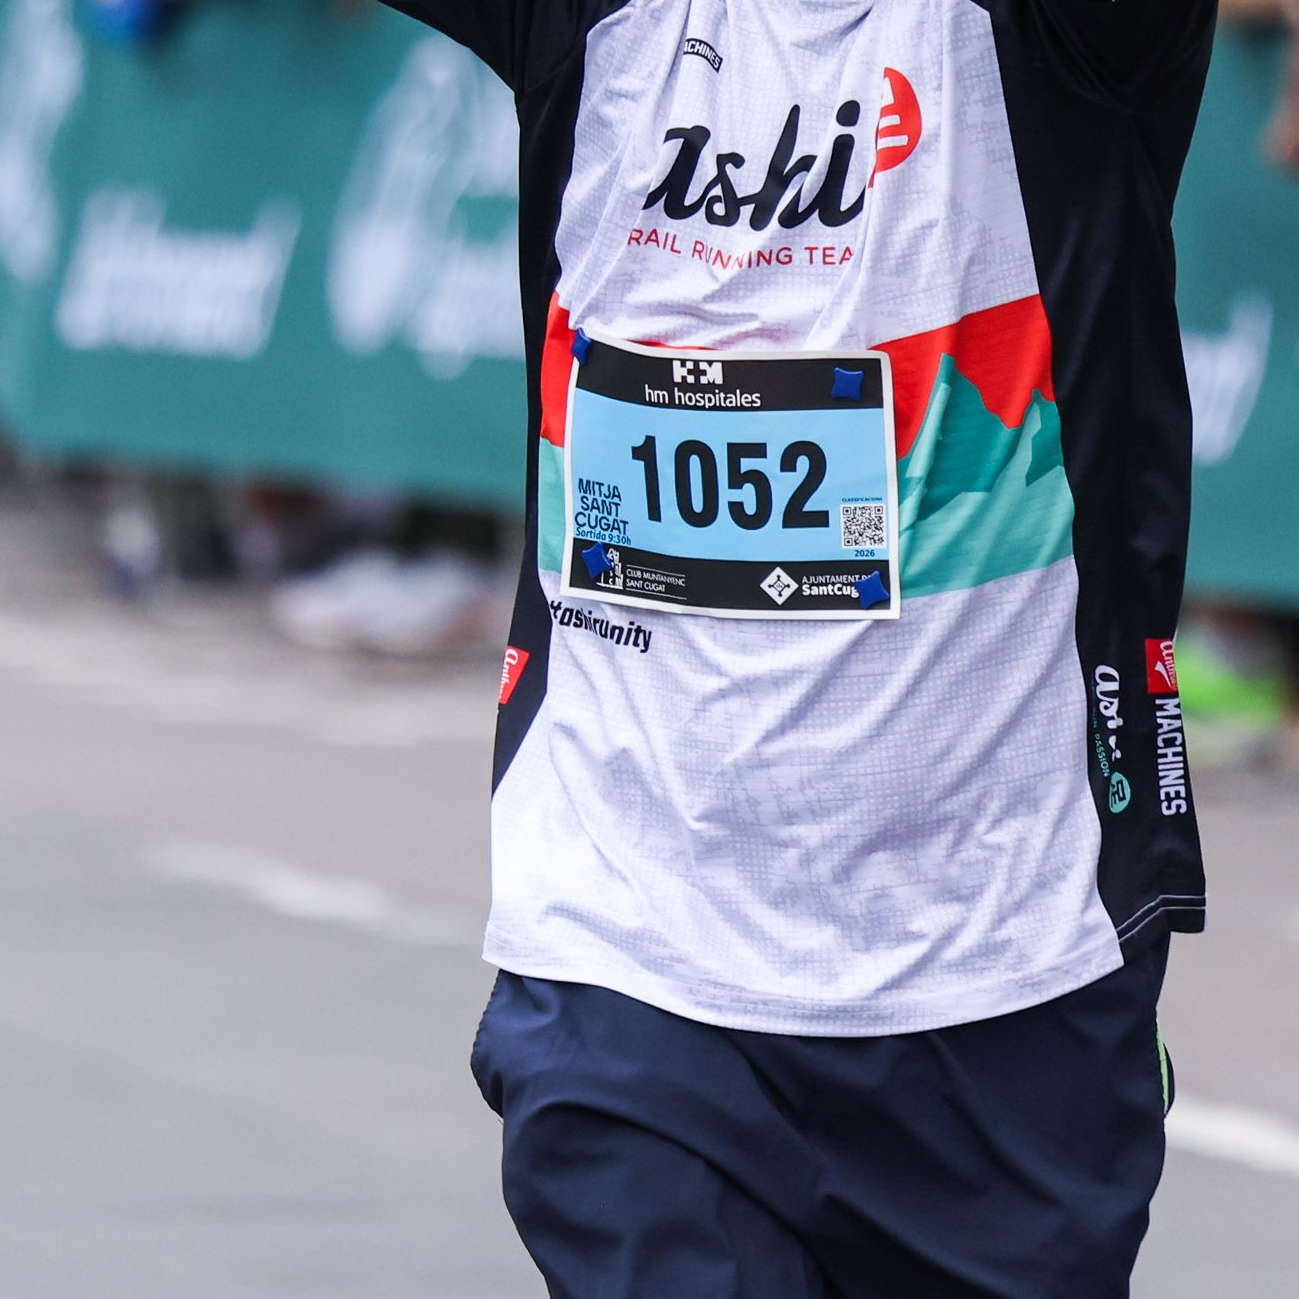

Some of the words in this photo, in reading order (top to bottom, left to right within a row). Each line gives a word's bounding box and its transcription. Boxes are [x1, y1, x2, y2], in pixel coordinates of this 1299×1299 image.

[627, 228, 682, 255] RAIL
[804, 245, 856, 266] TEA
[644, 384, 669, 405] hm
[674, 386, 762, 410] hospitales
[577, 477, 622, 502] MITJA
[630, 434, 830, 531] 1052
[580, 494, 621, 517] SANT
[574, 511, 629, 535] CUGAT
[576, 527, 606, 540] Sortida
[608, 534, 631, 545] 9:30h
[854, 548, 876, 558] 2026
[625, 568, 642, 579] CLUB
[625, 578, 643, 589] SANT
[643, 581, 666, 592] CUGAT
[801, 574, 861, 584] AJUNTAMENT
[801, 583, 861, 599] SantCug
[1093, 733, 1110, 778] PASSION
[1154, 696, 1188, 816] MACHINES
